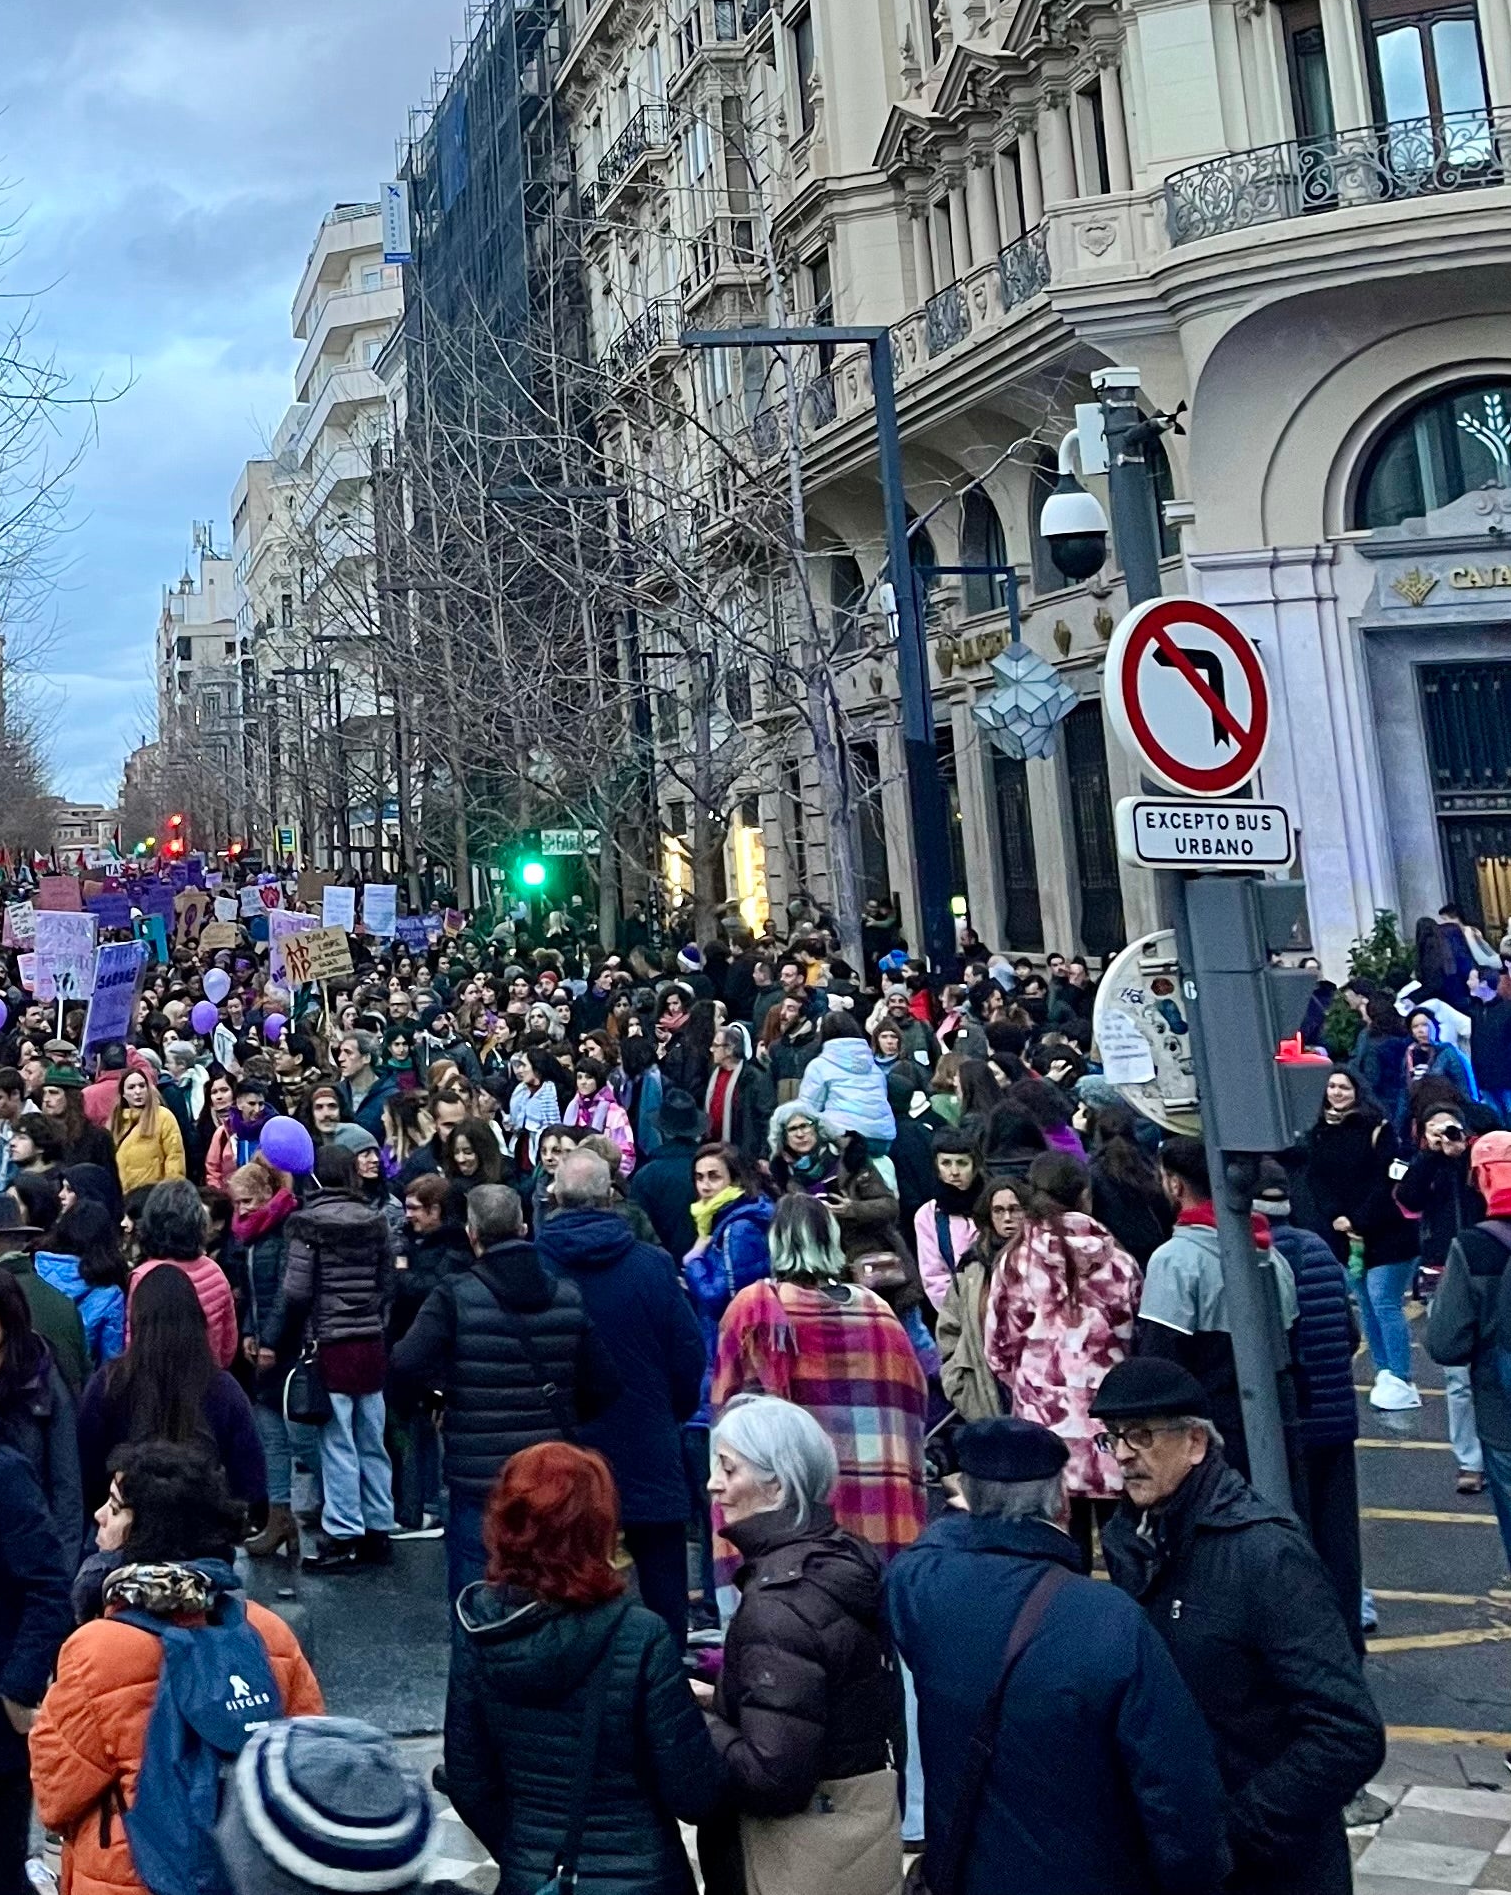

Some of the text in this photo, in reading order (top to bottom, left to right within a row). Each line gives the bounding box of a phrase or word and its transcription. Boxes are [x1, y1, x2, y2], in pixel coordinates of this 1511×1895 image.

[1145, 812, 1273, 831] EXCEPTO BUS
[1175, 838, 1254, 856] URBANO
[225, 1692, 270, 1711] SITGES
